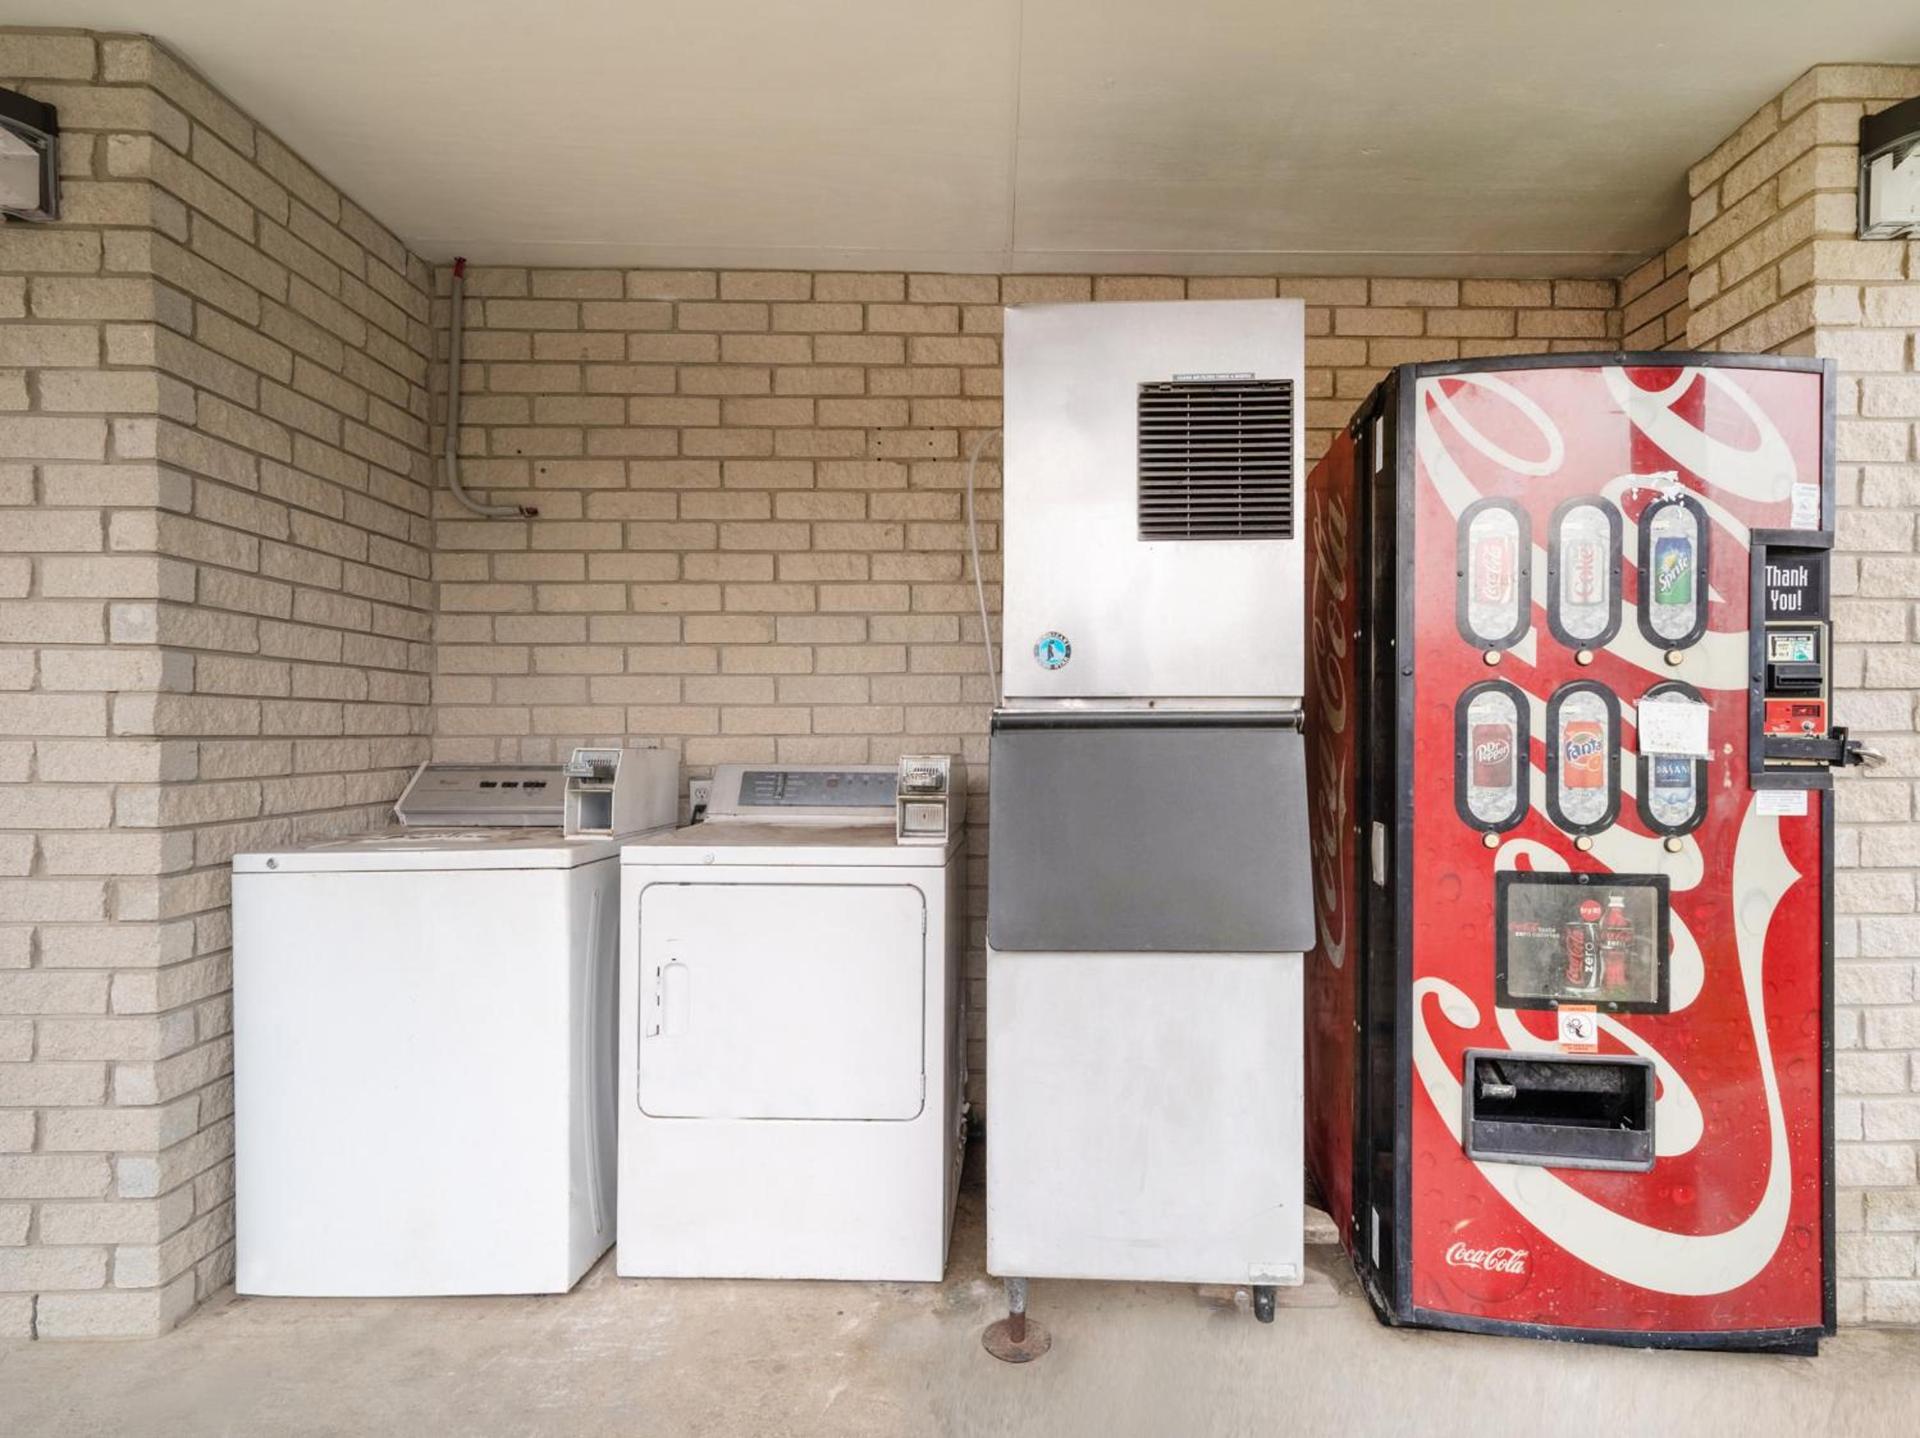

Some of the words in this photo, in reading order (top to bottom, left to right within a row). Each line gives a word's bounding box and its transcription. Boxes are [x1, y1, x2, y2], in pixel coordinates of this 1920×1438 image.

[1575, 544, 1595, 601] Coke
[1658, 554, 1689, 592] Sprite
[1765, 565, 1808, 588] Thank
[1770, 590, 1803, 611] You!
[1476, 745, 1508, 763] Pepper
[1486, 742, 1501, 751] Dr
[1565, 929, 1585, 985] Coca-Cola
[1584, 942, 1594, 973] zero
[1446, 1242, 1529, 1274] Coca-Cola
